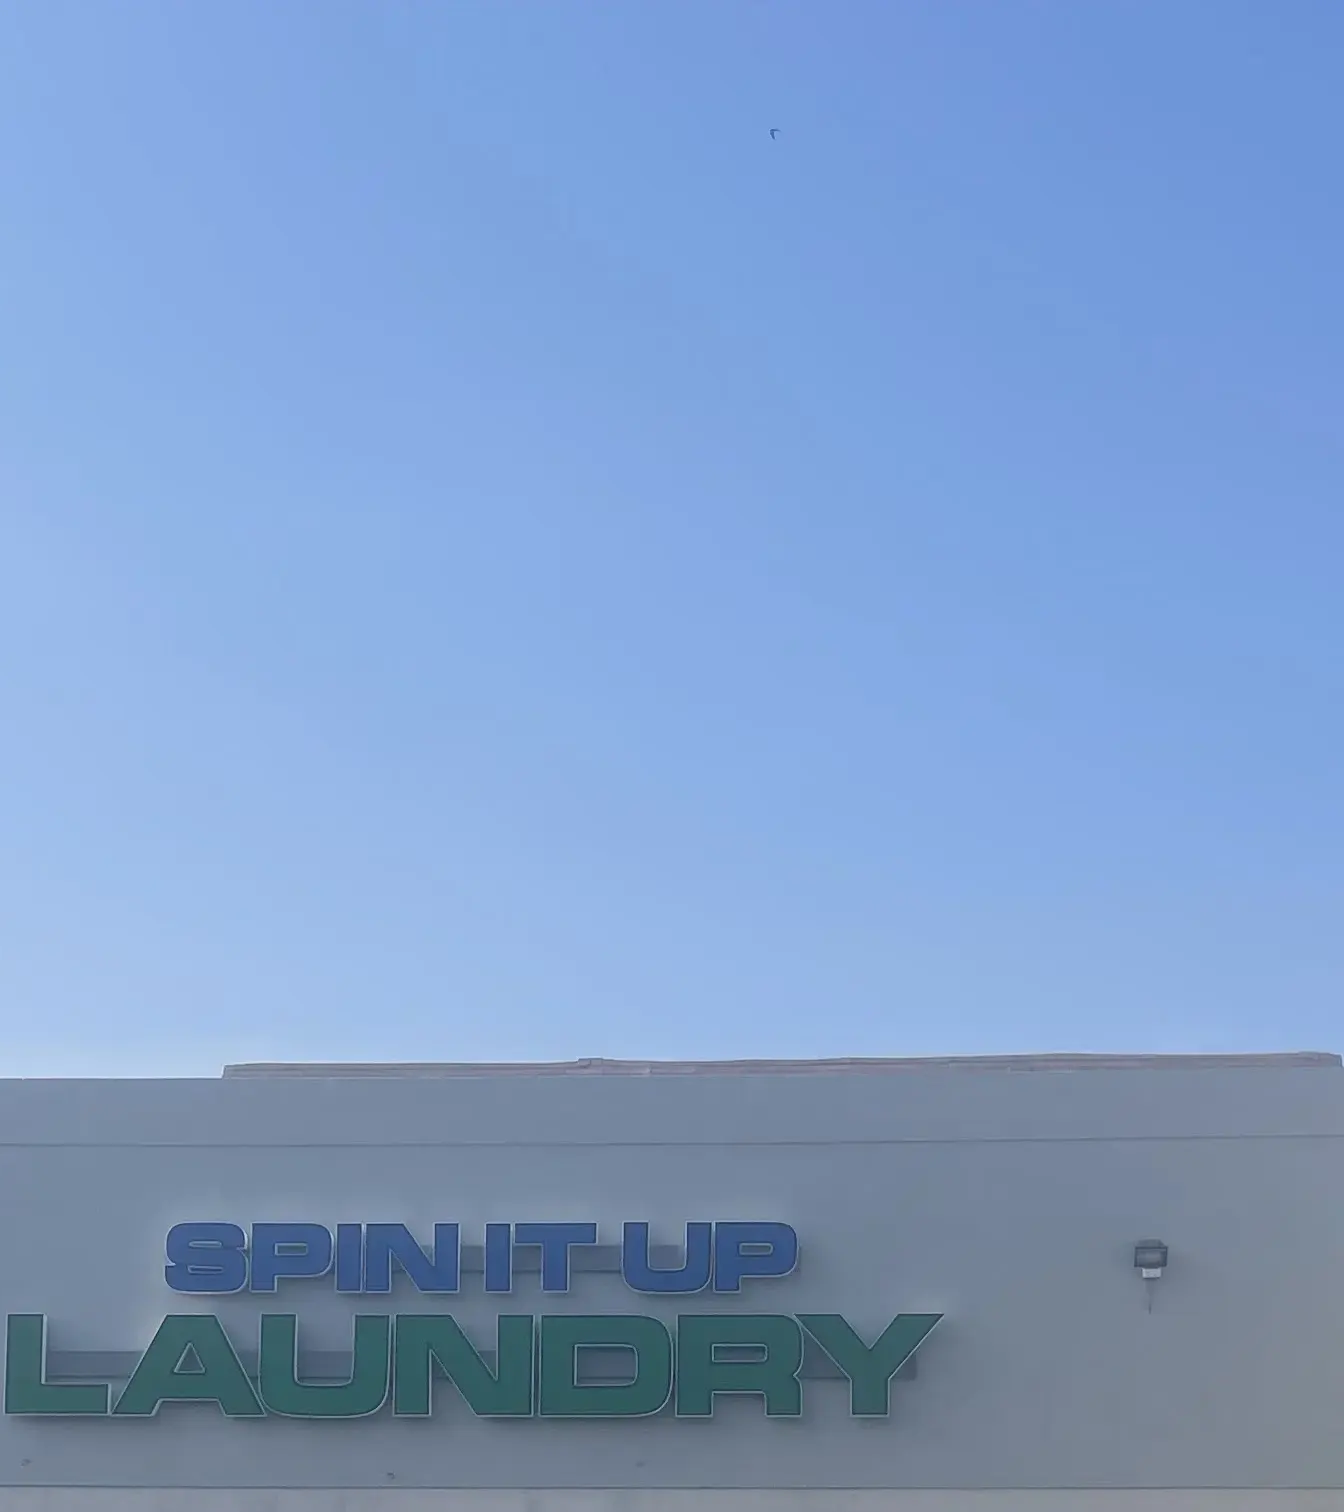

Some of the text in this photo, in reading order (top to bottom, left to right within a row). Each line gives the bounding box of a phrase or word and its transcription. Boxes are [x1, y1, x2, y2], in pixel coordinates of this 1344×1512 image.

[164, 1221, 800, 1294] SPIN IT UP
[4, 1312, 944, 1418] LAUNDRY
